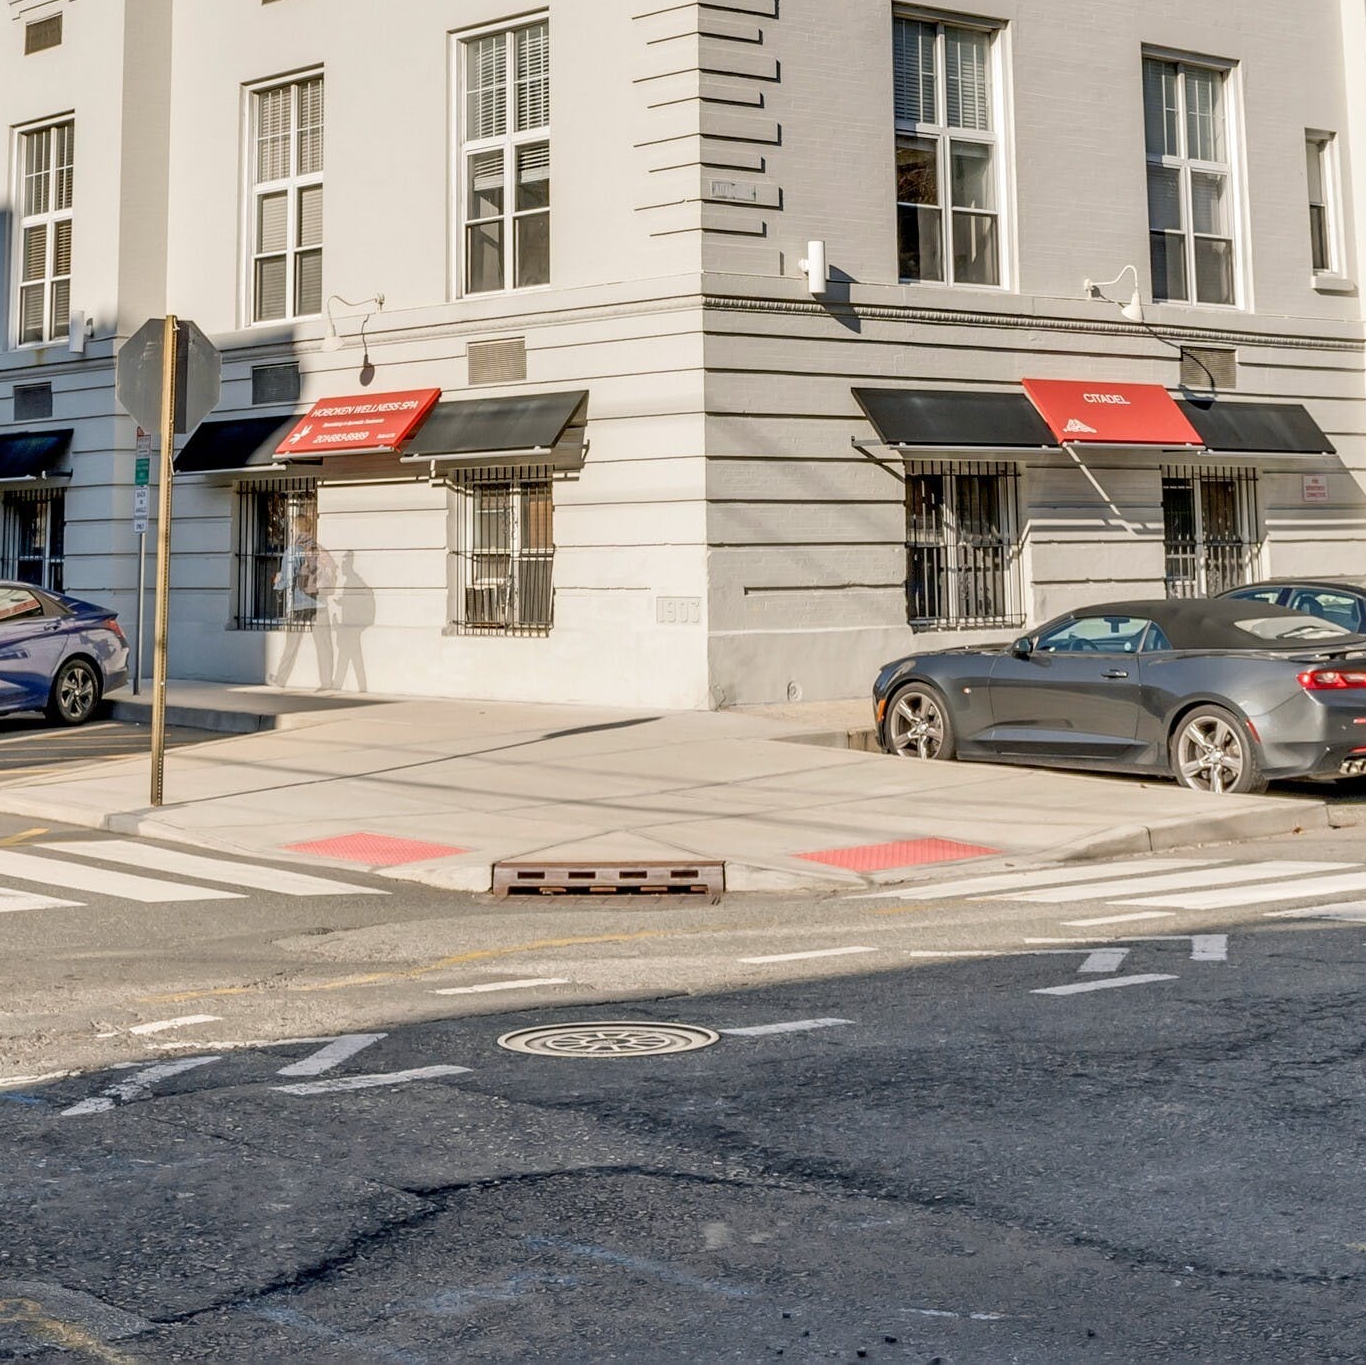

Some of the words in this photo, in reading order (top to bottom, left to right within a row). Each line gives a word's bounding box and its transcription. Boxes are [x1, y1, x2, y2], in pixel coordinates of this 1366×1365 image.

[1083, 393, 1131, 405] CITADEL
[311, 405, 355, 418] HOBOKEN
[353, 402, 401, 415] WELLNESS
[400, 400, 418, 410] SPA
